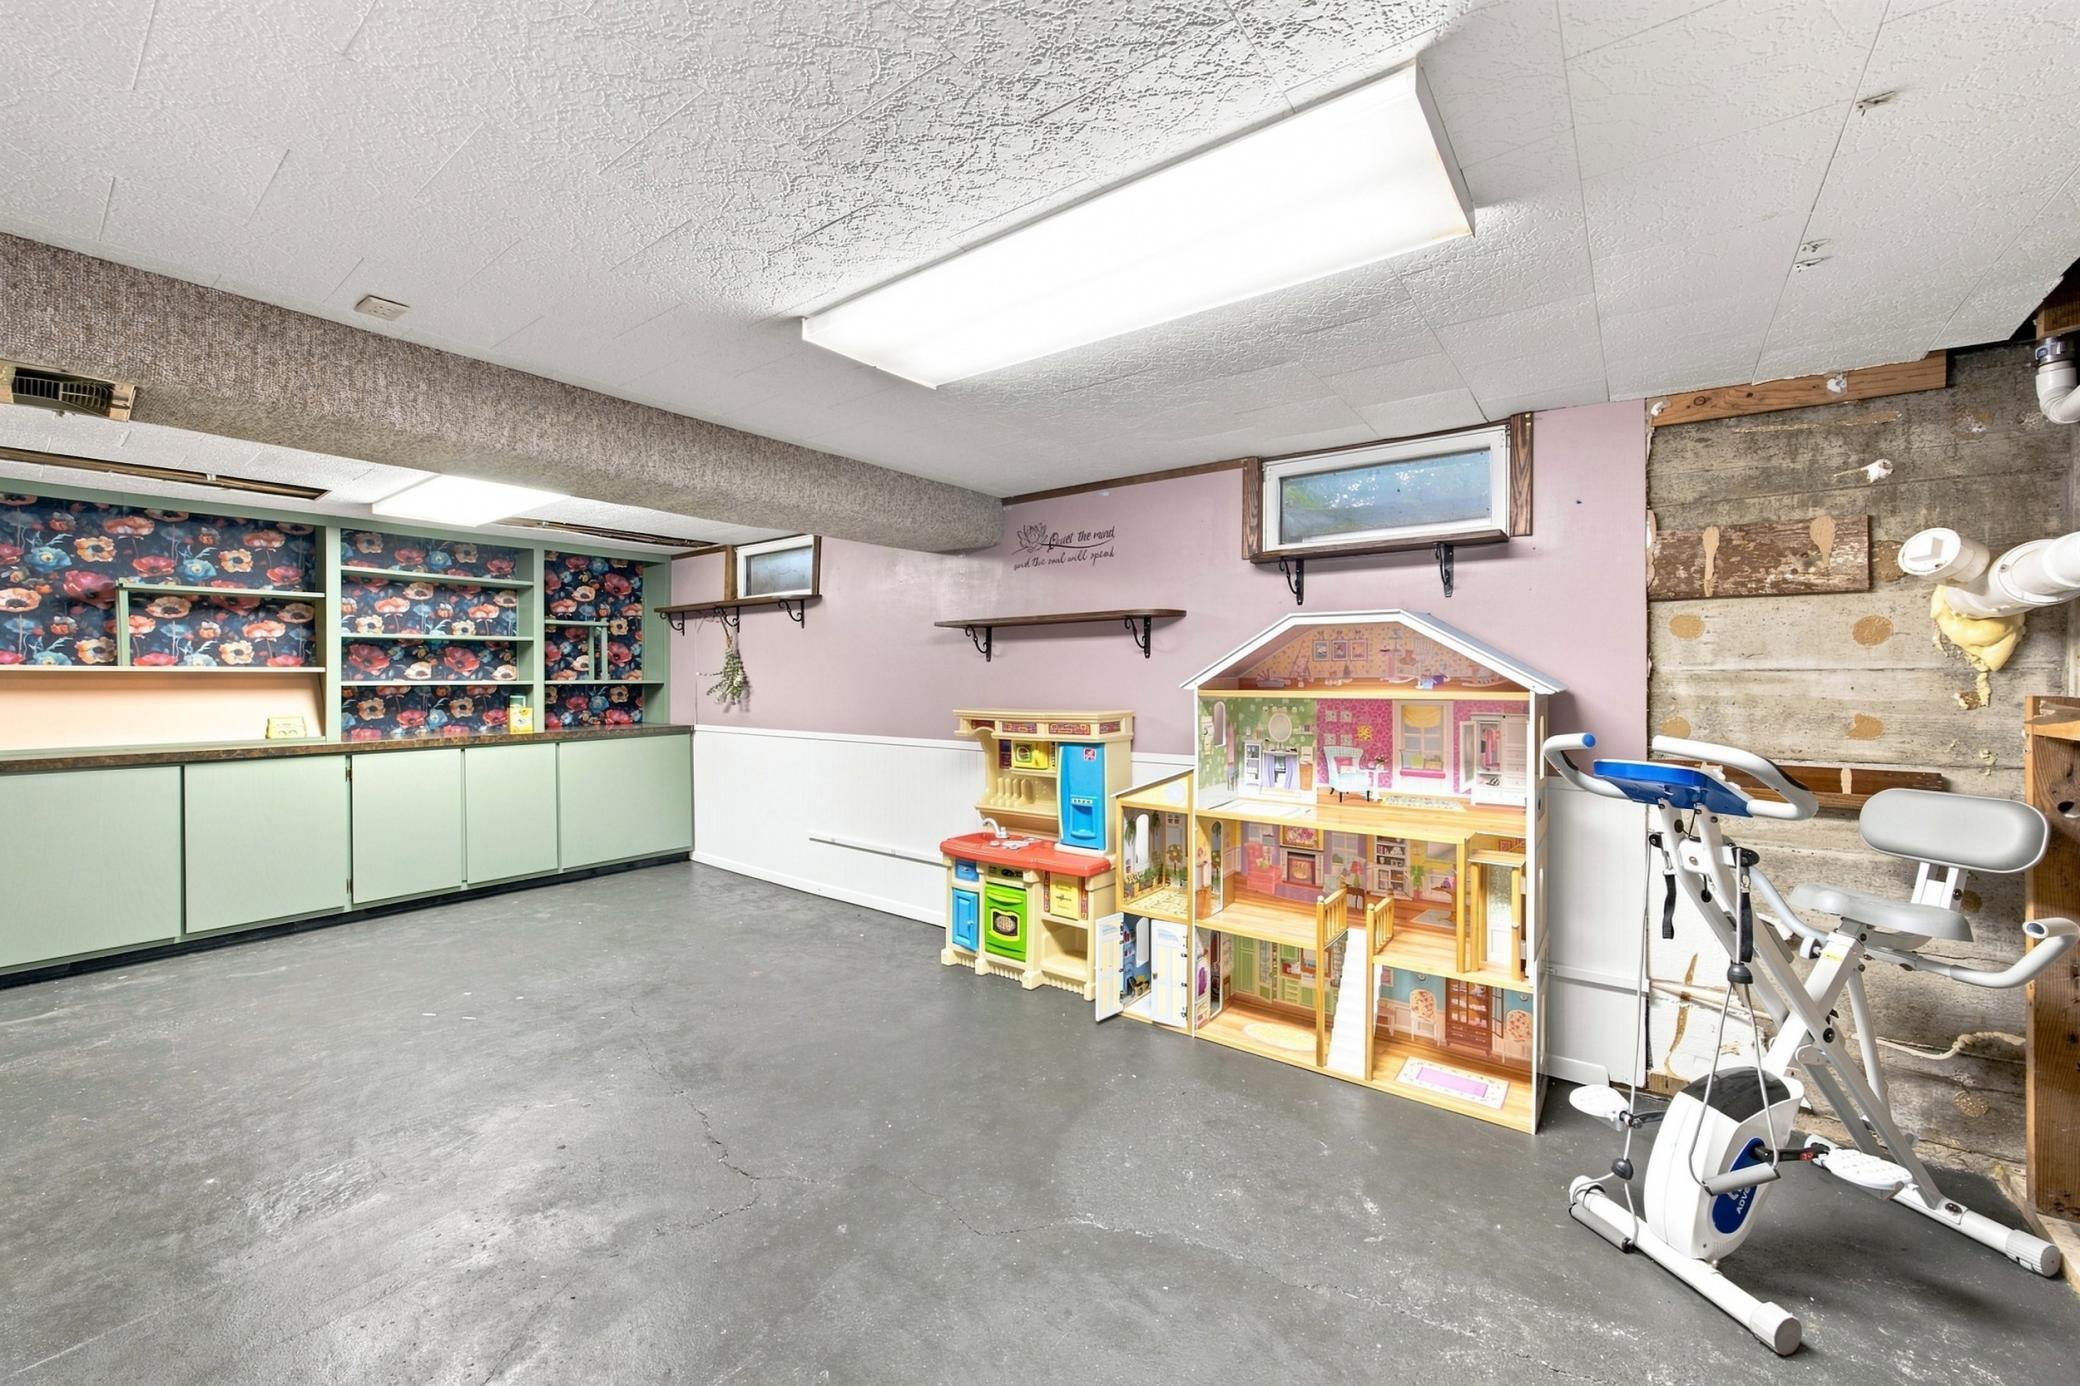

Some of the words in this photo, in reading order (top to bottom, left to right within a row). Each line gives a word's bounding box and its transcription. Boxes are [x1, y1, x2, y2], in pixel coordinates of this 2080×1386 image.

[1077, 530, 1091, 542] the
[1093, 526, 1115, 540] mind
[1014, 558, 1031, 571] and
[1032, 557, 1045, 567] the
[1047, 552, 1065, 565] soul
[1067, 549, 1087, 562] will
[1090, 546, 1115, 567] speak
